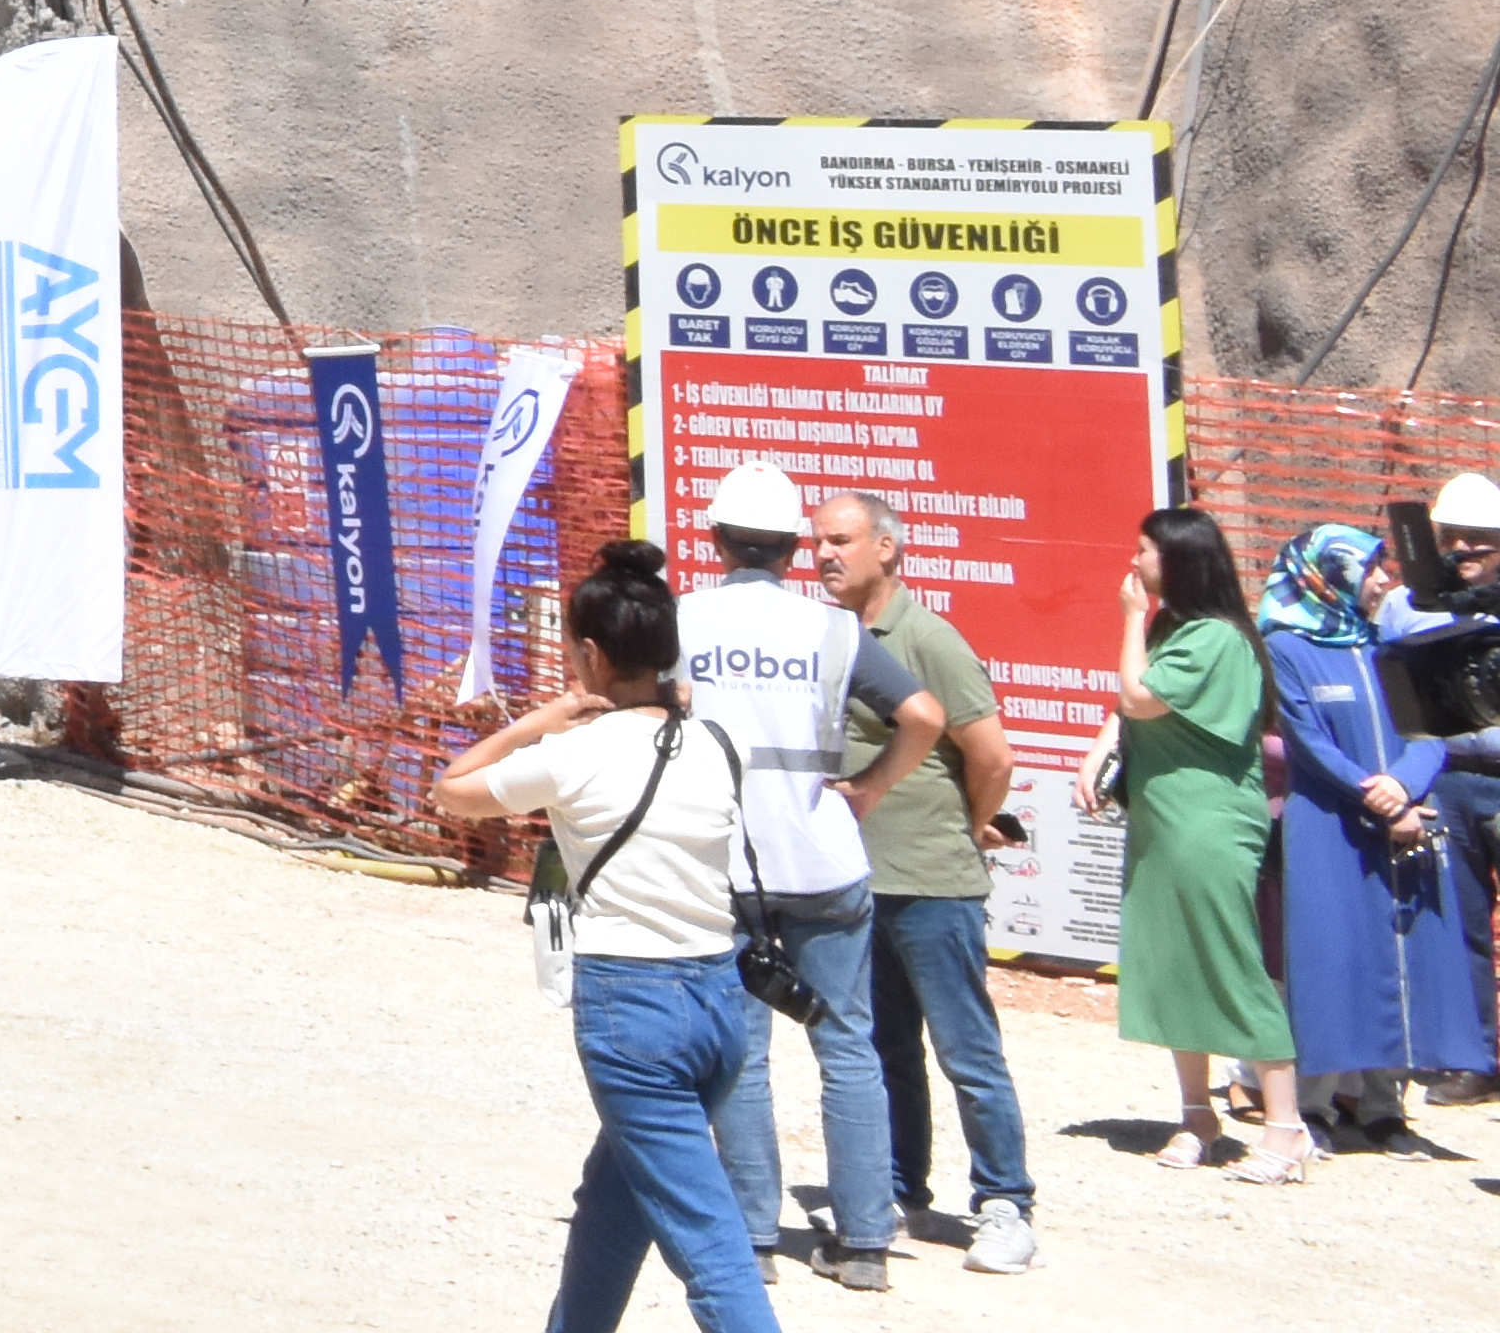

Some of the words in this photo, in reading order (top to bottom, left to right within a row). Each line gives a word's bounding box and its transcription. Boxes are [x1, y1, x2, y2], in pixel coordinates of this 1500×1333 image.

[703, 166, 790, 192] kalyon
[820, 156, 894, 170] BANDIRMA
[908, 158, 955, 172] BURSA
[968, 158, 1042, 175] YENİŞEHİR
[1055, 160, 1129, 175] OSMANELİ
[829, 175, 882, 189] YÜKSEK
[886, 177, 971, 192] STANDARTLI
[976, 178, 1057, 194] DEMİRYOLU
[1062, 181, 1121, 195] PROJESİ
[732, 213, 820, 245] ÖNCE
[829, 215, 863, 253] İŞ
[873, 216, 1059, 254] GÜVENLİĞİ
[678, 319, 720, 330] BARET
[686, 332, 712, 343] TAK
[19, 242, 100, 489] AYGM
[863, 363, 928, 384] TALİMAT
[672, 384, 684, 402] 1-
[686, 380, 699, 407] İŞ
[702, 382, 768, 407] GÜVENLİĞİ
[770, 386, 823, 409] TALİMAT
[826, 391, 843, 412] VE
[845, 388, 923, 416] İKAZLARINA
[926, 396, 943, 417] UY
[673, 414, 687, 434] 2-
[689, 412, 731, 437] GÖREV
[733, 418, 749, 438] VE
[751, 417, 796, 440] YETKİN
[800, 423, 853, 446] DIŞINDA
[855, 421, 869, 448] İŞ
[870, 426, 918, 448] YAPMA
[674, 446, 689, 466] 3-
[691, 445, 740, 468] TEHLİKE
[823, 454, 863, 479] KARŞI
[866, 456, 915, 480] UYANIK
[918, 460, 934, 480] OL
[675, 477, 690, 496] 4-
[804, 485, 822, 506] VE
[911, 491, 976, 518] YETKİLİYE
[979, 494, 1026, 520] BİLDİR
[336, 463, 366, 614] kalyon
[912, 523, 959, 547] BİLDİR
[678, 541, 692, 561] 6-
[904, 552, 951, 579] İZİNSİZ
[954, 561, 1014, 584] AYRILMA
[679, 571, 692, 590] 7-
[924, 589, 951, 612] TUT
[690, 645, 818, 687] global
[990, 657, 1010, 682] İLE
[1004, 696, 1064, 722] SEYAHAT
[1067, 701, 1105, 725] ETME
